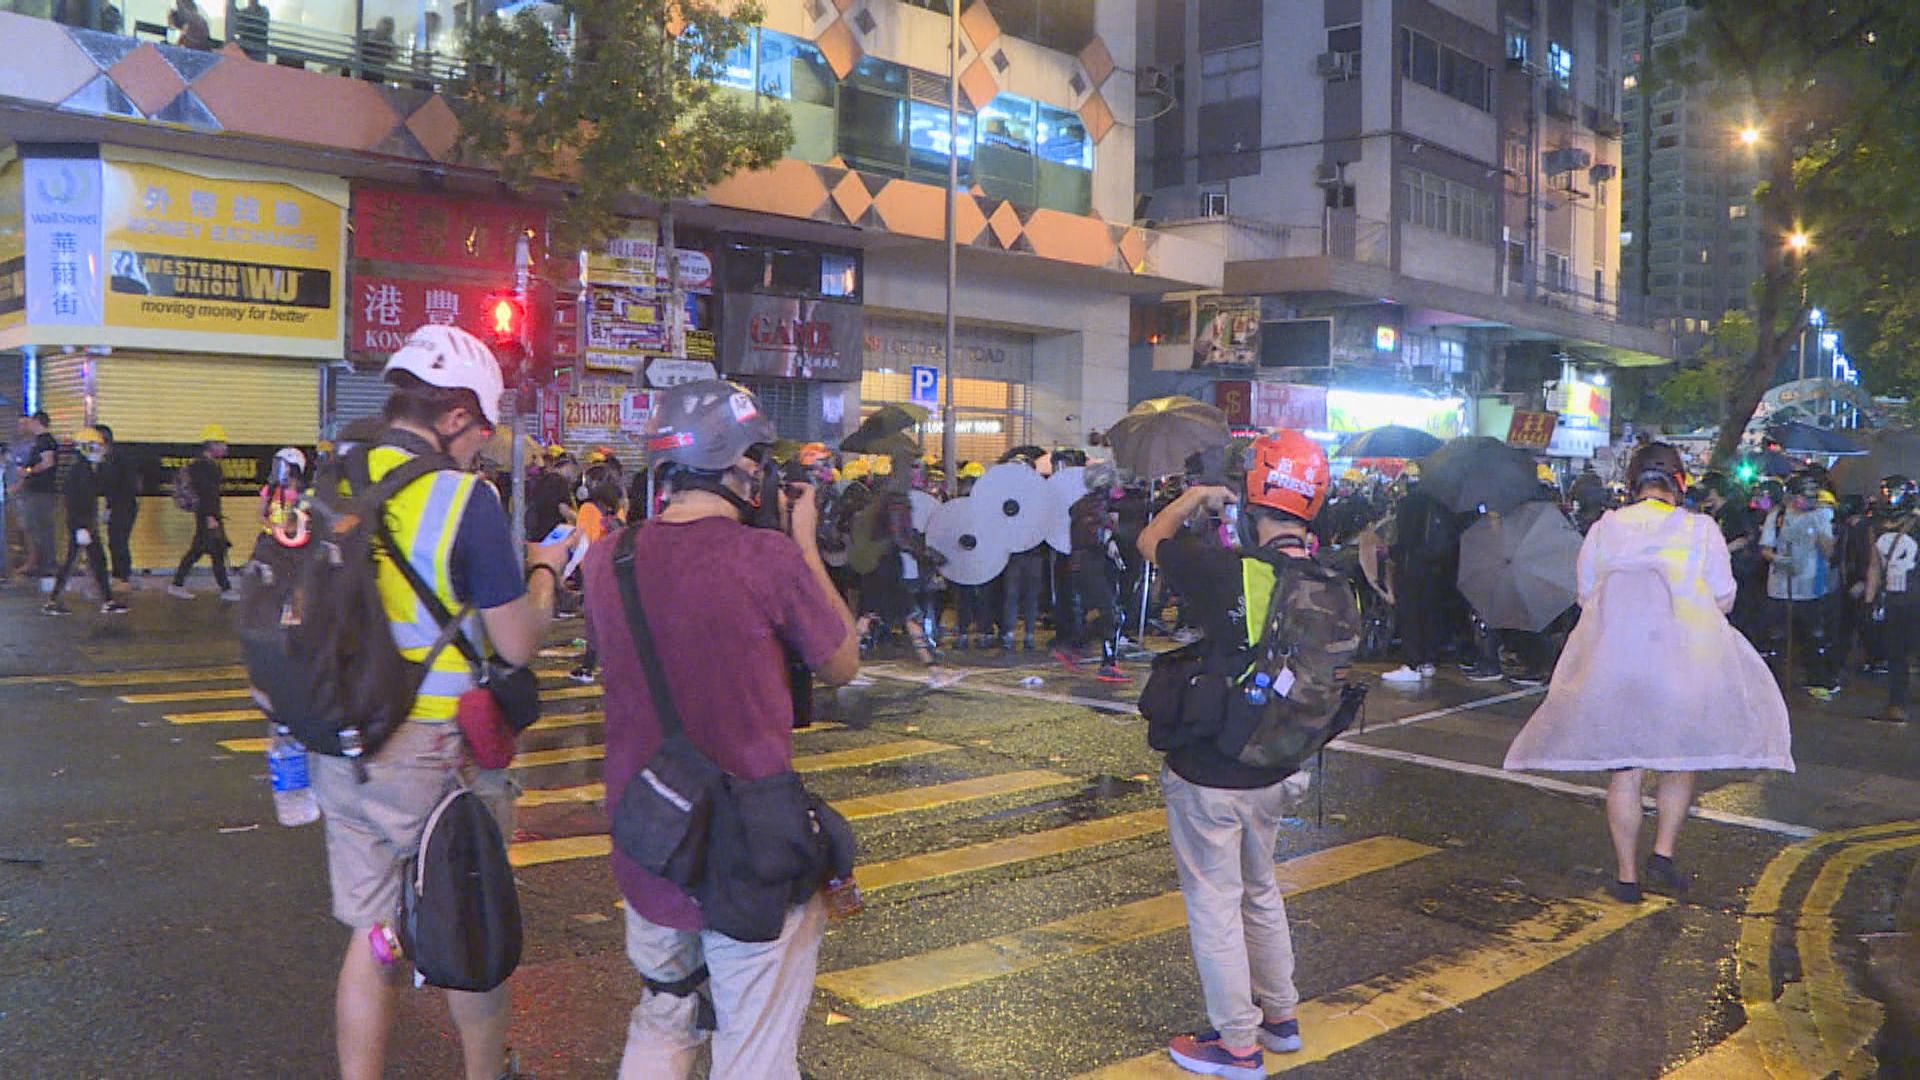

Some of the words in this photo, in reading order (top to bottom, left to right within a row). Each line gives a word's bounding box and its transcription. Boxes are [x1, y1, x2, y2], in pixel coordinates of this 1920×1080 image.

[127, 216, 203, 240] MONEY
[211, 225, 317, 250] EXCHANGE
[51, 231, 77, 315] 華爾街
[144, 257, 238, 283] WESTERN
[243, 266, 300, 302] WU
[175, 277, 238, 298] UNION
[141, 301, 195, 319] moving
[198, 305, 245, 321] money
[248, 307, 268, 321] for
[269, 309, 308, 323] better
[916, 369, 935, 401] P
[1267, 470, 1316, 498] PRESS
